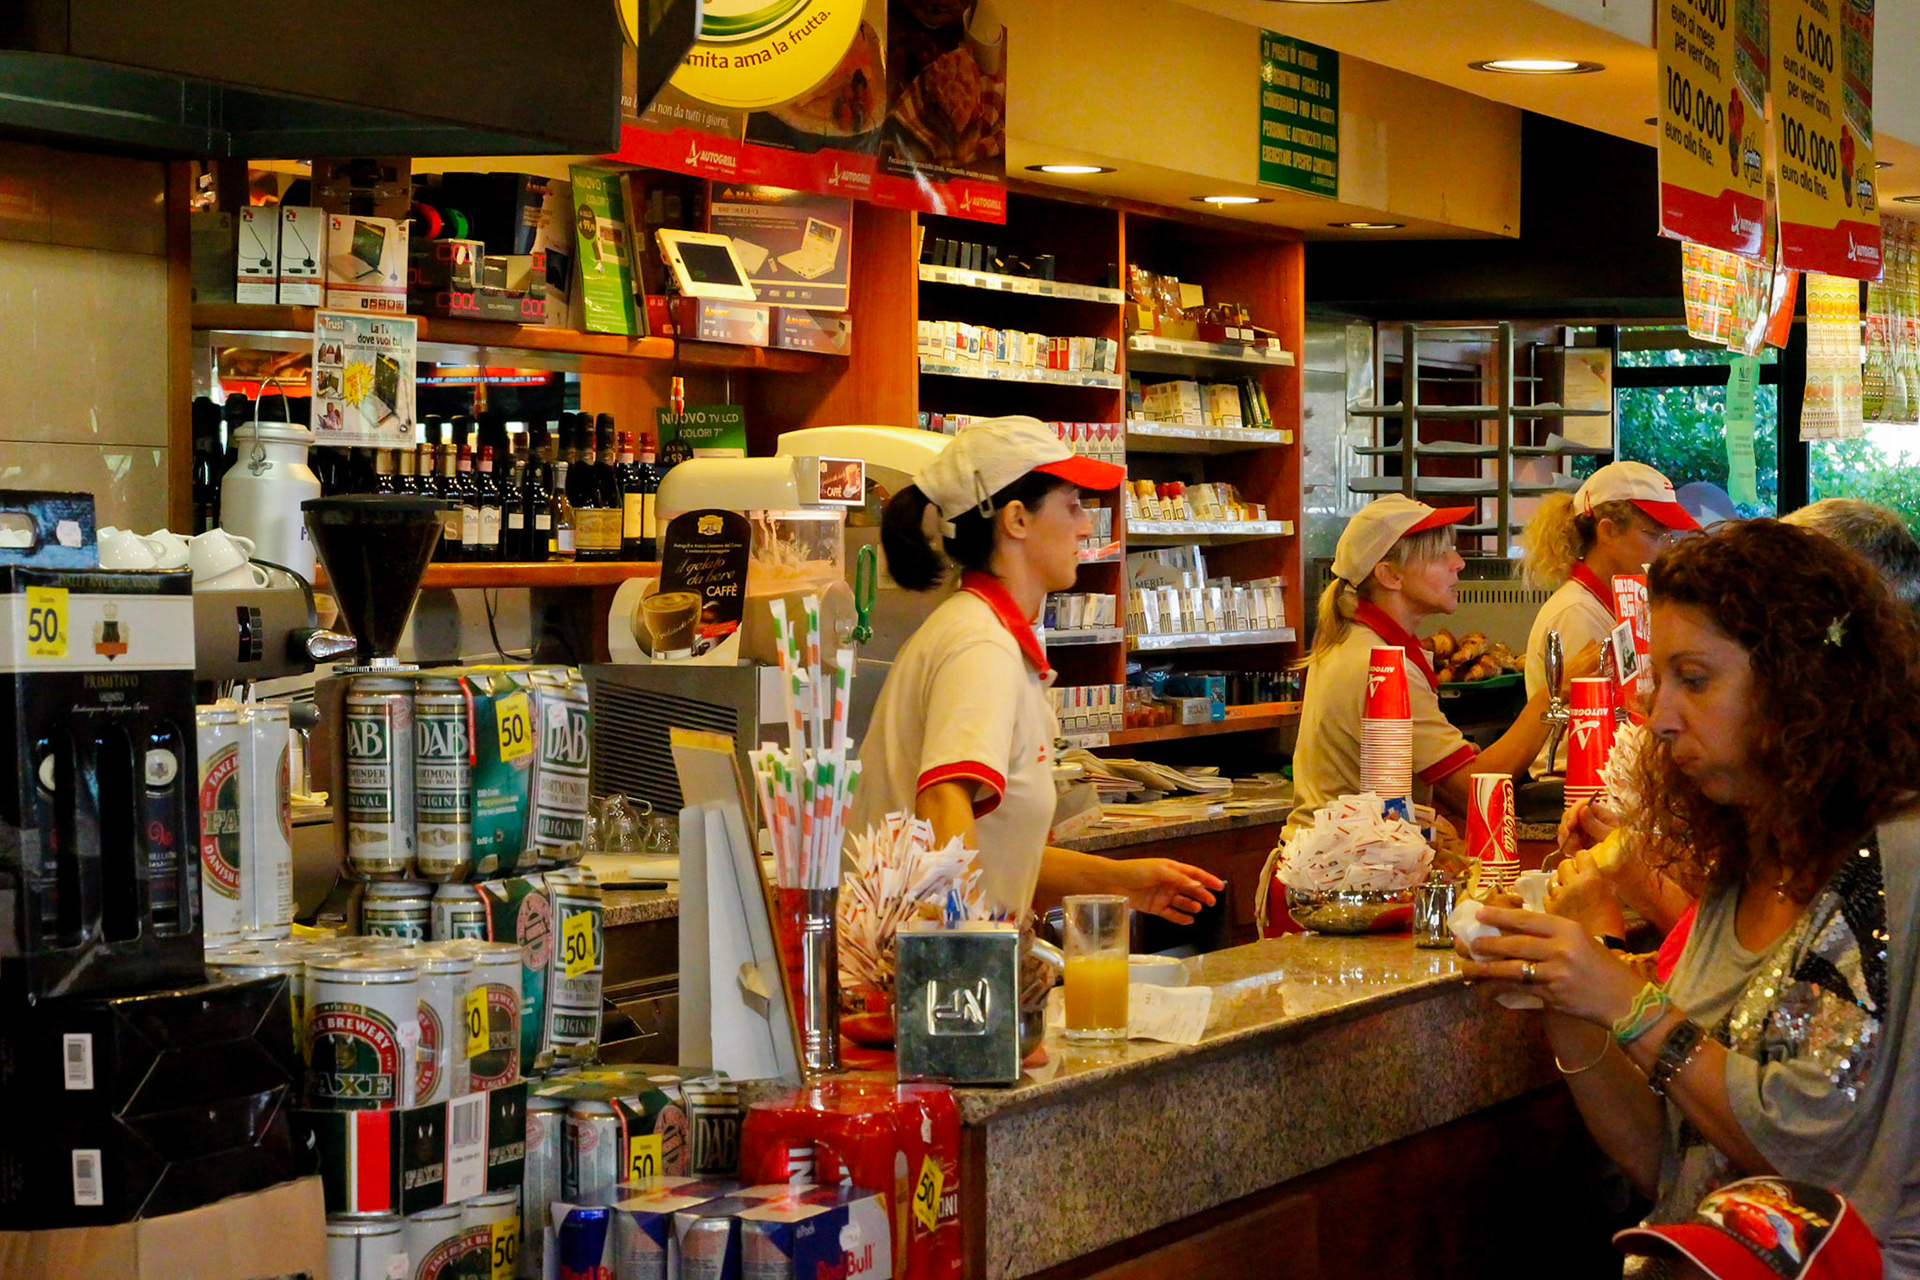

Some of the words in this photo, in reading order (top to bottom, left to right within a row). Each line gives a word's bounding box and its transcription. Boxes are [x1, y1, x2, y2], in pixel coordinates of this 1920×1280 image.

[734, 49, 772, 68] ama
[772, 41, 789, 55] la
[788, 10, 831, 45] frutta.
[1671, 4, 1687, 29] euro
[1696, 24, 1715, 51] mese
[1675, 32, 1687, 52] per
[1796, 14, 1833, 74] 6.000
[1783, 54, 1799, 77] euro
[1807, 70, 1825, 94] mese
[1787, 80, 1799, 99] per
[658, 104, 672, 117] non
[674, 104, 684, 118] da
[685, 108, 701, 123] tutti
[1667, 65, 1724, 146] 100.000
[1665, 121, 1682, 145] euro
[1683, 130, 1697, 155] alla
[1781, 112, 1836, 180] 100.000
[700, 150, 737, 168] AUTOGRILL
[841, 170, 871, 185] AUTOGRILL
[1782, 164, 1799, 185] euro
[1800, 170, 1813, 192] alla
[325, 317, 344, 330] Trust
[370, 323, 379, 334] La
[358, 333, 375, 344] dove
[376, 335, 391, 346] vuoi
[680, 428, 712, 438] COLORI
[709, 413, 720, 422] TV
[722, 413, 739, 423] LCD
[684, 556, 726, 579] gelato
[686, 570, 704, 585] da
[705, 568, 736, 583] bere
[706, 582, 738, 597] CAFFÈ
[1135, 577, 1165, 589] MERIT
[28, 608, 58, 643] 50
[83, 674, 139, 688] PRIMITIVO
[417, 721, 469, 757] DAB
[502, 713, 523, 748] 50
[545, 710, 588, 765] DAB
[208, 758, 232, 786] FAXE
[204, 844, 235, 882] DANISH
[566, 931, 587, 967] 50
[327, 1017, 392, 1049] BREWERY
[697, 1118, 737, 1170] DAB
[632, 1153, 655, 1180] 50
[917, 1173, 936, 1211] 50
[494, 1234, 516, 1269] 50
[846, 1244, 873, 1277] Bull
